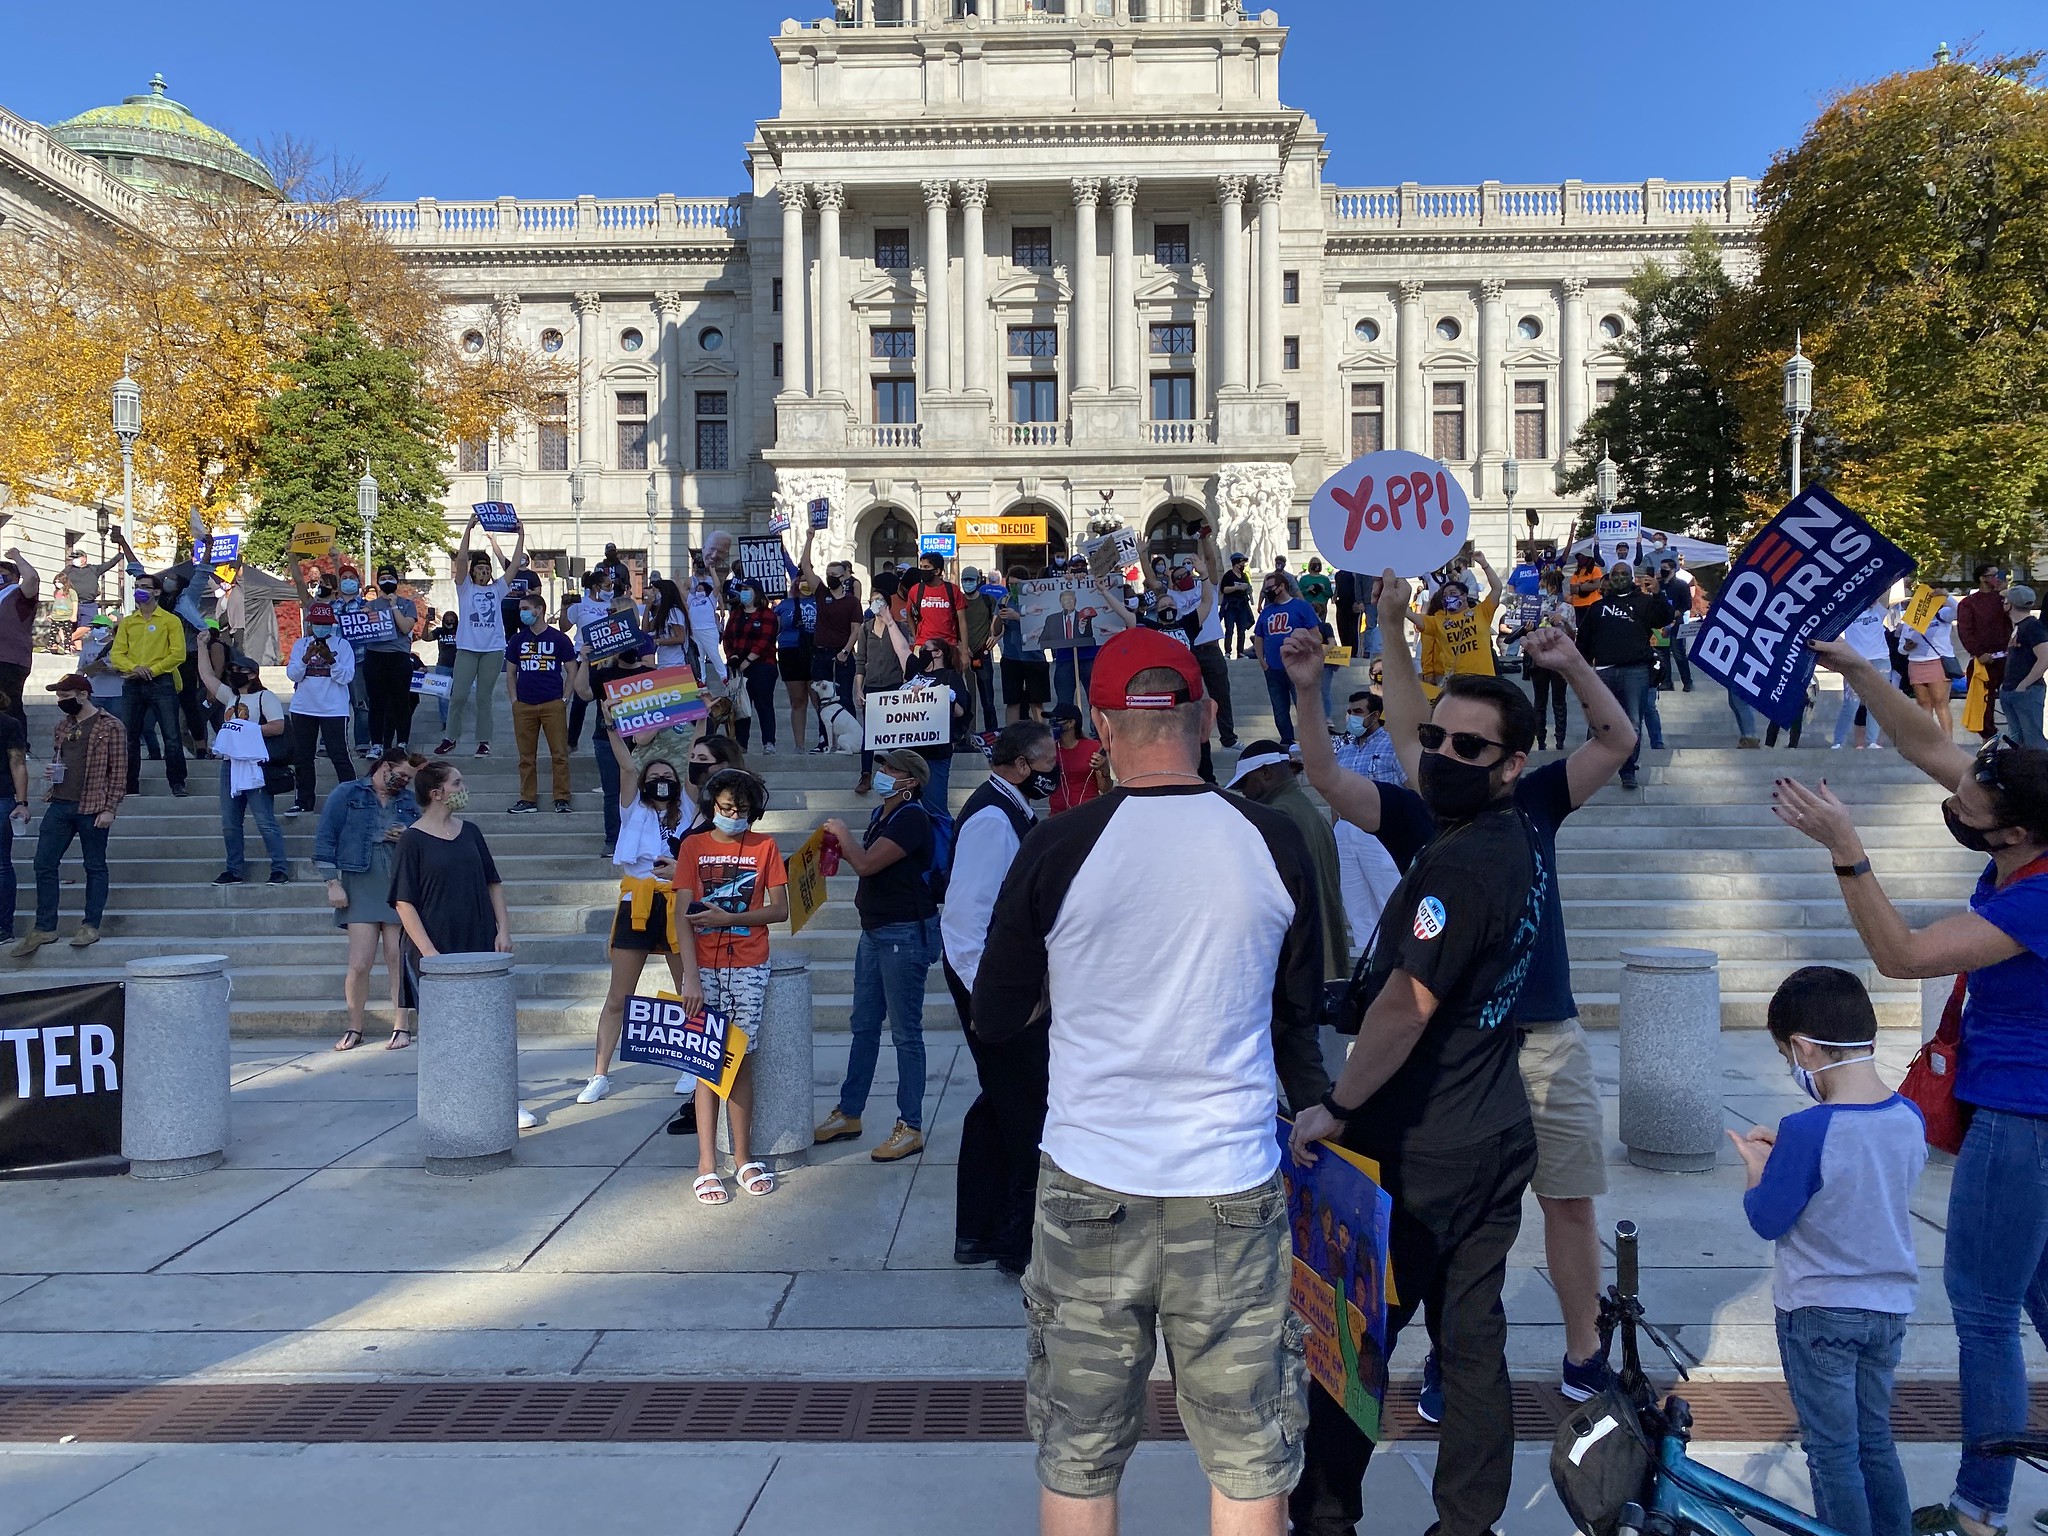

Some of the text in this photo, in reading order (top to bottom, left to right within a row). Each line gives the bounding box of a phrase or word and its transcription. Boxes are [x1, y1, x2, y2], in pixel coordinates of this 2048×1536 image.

[474, 503, 515, 514] BIDEN
[811, 500, 828, 511] DEN
[480, 513, 518, 523] HARRIS
[812, 510, 828, 520] RRIS
[966, 523, 1036, 534] VOTERS DECIDE
[1600, 520, 1637, 529] BIDEN
[305, 537, 330, 545] DECIDE
[923, 537, 952, 545] BIDEN
[198, 544, 235, 553] DECRACY
[740, 543, 783, 561] BACK
[742, 560, 785, 577] VOTERS
[1077, 576, 1111, 589] Fird
[1699, 496, 1843, 676] BIDEN
[921, 598, 950, 608] Bernie
[340, 610, 391, 626] BIDEN
[1734, 526, 1871, 697] HARRIS
[343, 621, 393, 635] HARRIS
[590, 620, 629, 641] BIDEN
[1769, 674, 1788, 703] Text
[1785, 614, 1821, 674] UNITED
[1822, 602, 1835, 616] to
[1834, 557, 1883, 602] 30330
[592, 629, 632, 649] HARRIS
[520, 641, 554, 655] SEIU
[1451, 640, 1478, 656] VOTE
[520, 660, 556, 671] BIDEN
[608, 678, 654, 699] Love
[614, 690, 682, 715] trumps
[879, 692, 937, 705] IT'S MATH,
[618, 710, 670, 731] hate.
[886, 711, 929, 723] DONNY.
[875, 731, 940, 745] NOT FRAUD!
[698, 855, 757, 865] SUPERSONIC
[1431, 903, 1441, 915] WE
[1420, 902, 1437, 933] VOTED
[629, 1000, 724, 1040] BIDEN
[627, 1023, 721, 1060] HARRIS
[0, 1023, 119, 1098] TER
[631, 1045, 646, 1053] Text
[648, 1047, 683, 1059] UNITED
[692, 1056, 715, 1071] 30330
